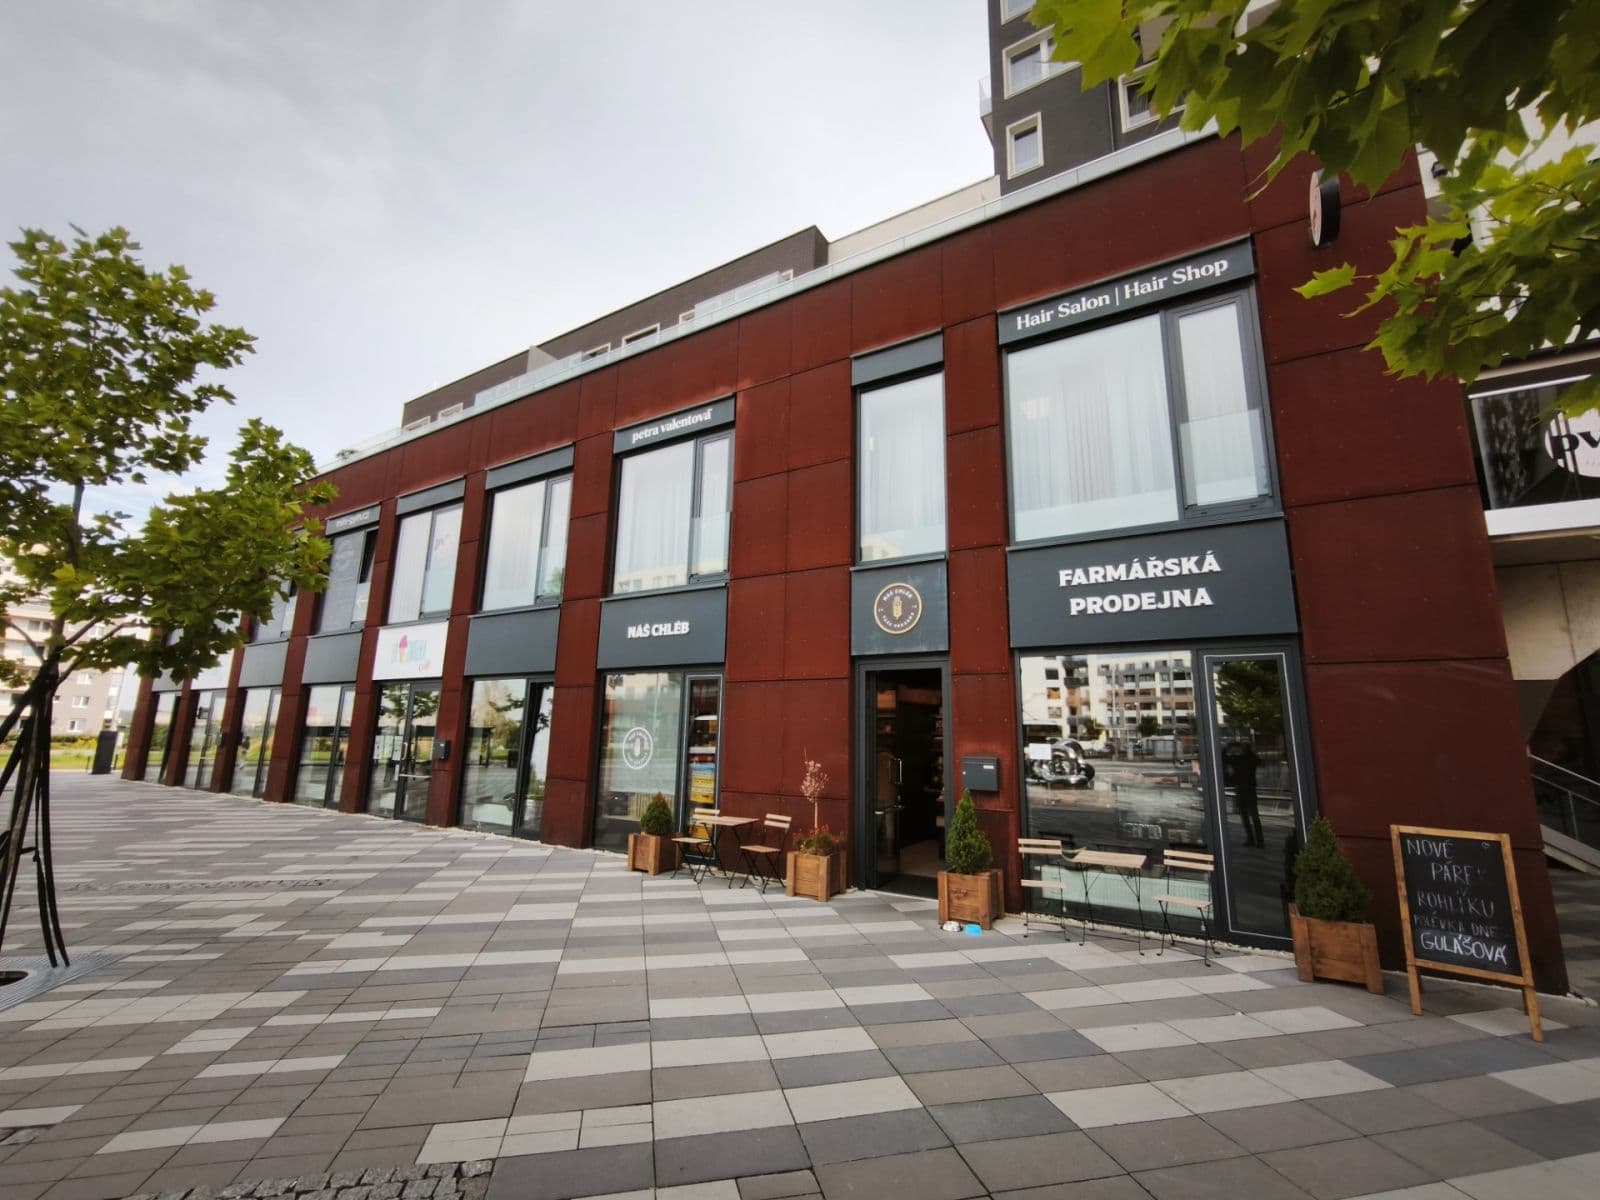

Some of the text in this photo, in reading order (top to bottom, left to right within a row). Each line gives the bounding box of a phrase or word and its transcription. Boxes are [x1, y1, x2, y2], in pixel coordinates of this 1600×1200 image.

[1016, 309, 1055, 331] Hair
[1057, 293, 1111, 318] Salon
[1124, 275, 1169, 300] Hair
[1172, 258, 1230, 286] Shop
[631, 407, 714, 445] petra valentová
[1058, 550, 1222, 588] FARMÁŘSKÁ
[1069, 587, 1215, 616] PRODEJNA
